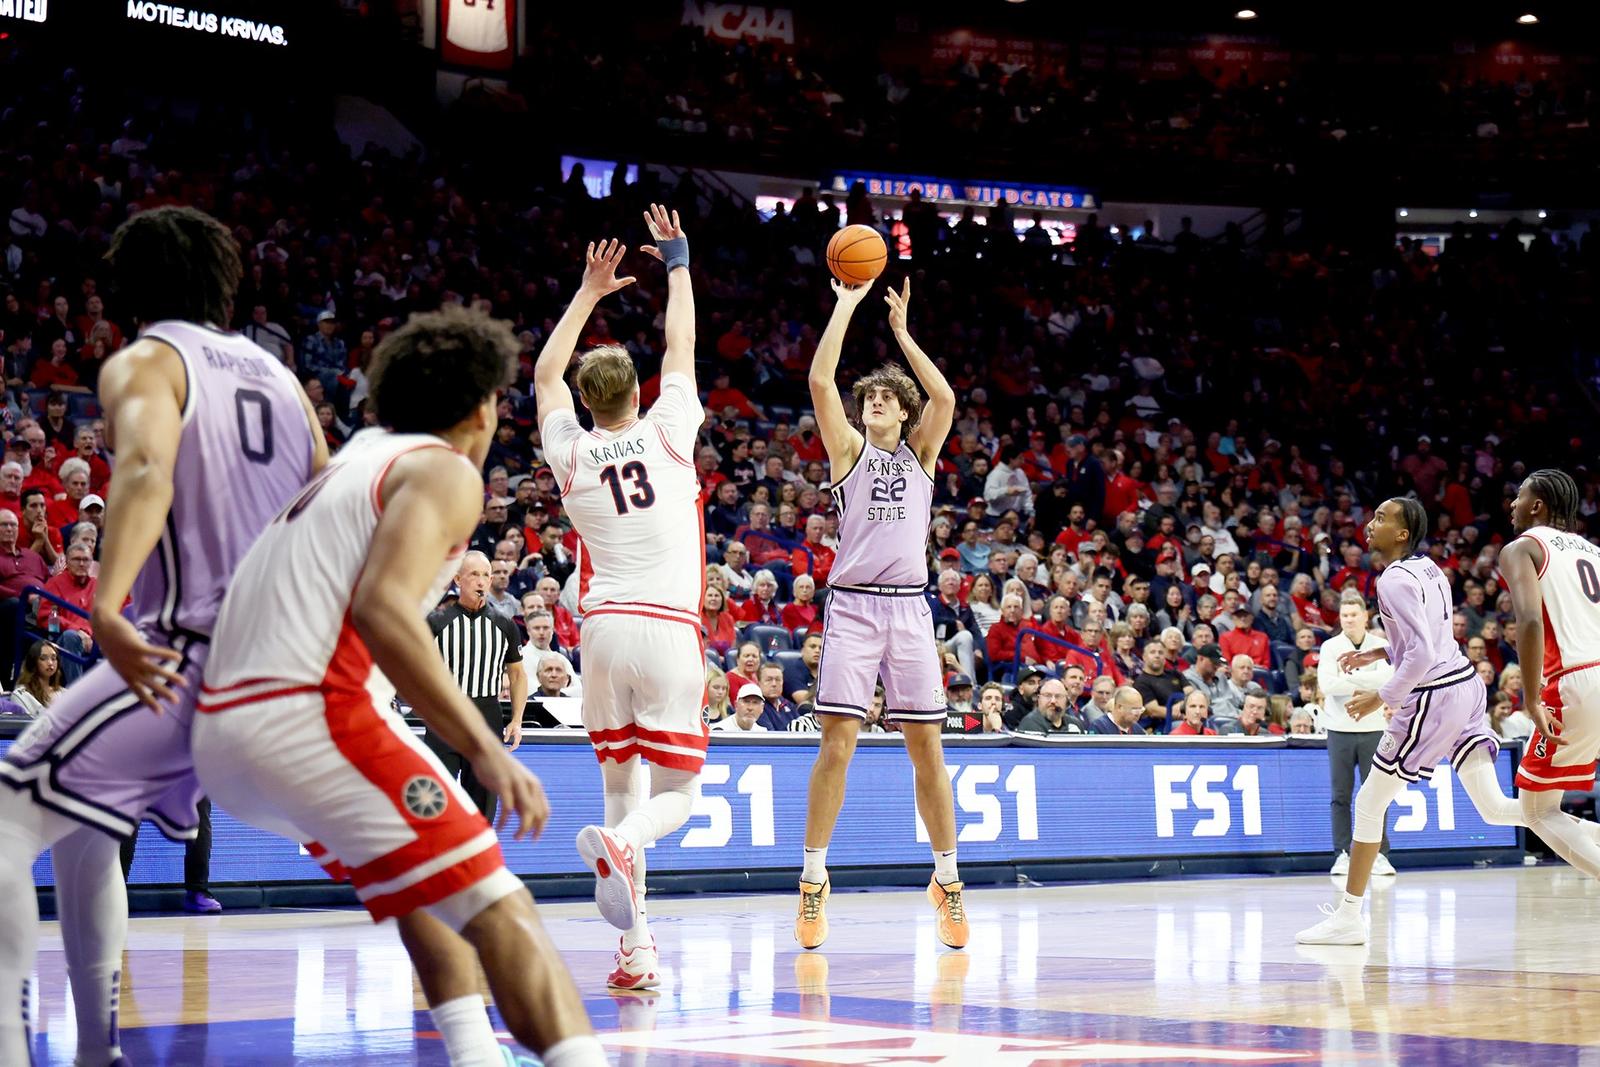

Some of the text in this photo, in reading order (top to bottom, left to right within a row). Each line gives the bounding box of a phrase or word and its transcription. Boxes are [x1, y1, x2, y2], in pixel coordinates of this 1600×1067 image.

[0, 0, 47, 22] ATED
[127, 0, 287, 46] MOTIEJUS KRIVAS.
[681, 0, 795, 44] NCAA
[855, 178, 954, 200] RIZONA
[963, 186, 1073, 208] WILDCATS
[235, 388, 274, 466] 0
[590, 438, 645, 464] KRIVAS
[867, 459, 913, 477] KNSAS
[599, 461, 656, 516] 13
[871, 477, 907, 503] 22
[867, 507, 906, 521] STATE
[1576, 558, 1600, 604] 0
[1153, 764, 1263, 837] FS1
[1393, 764, 1456, 832] S1
